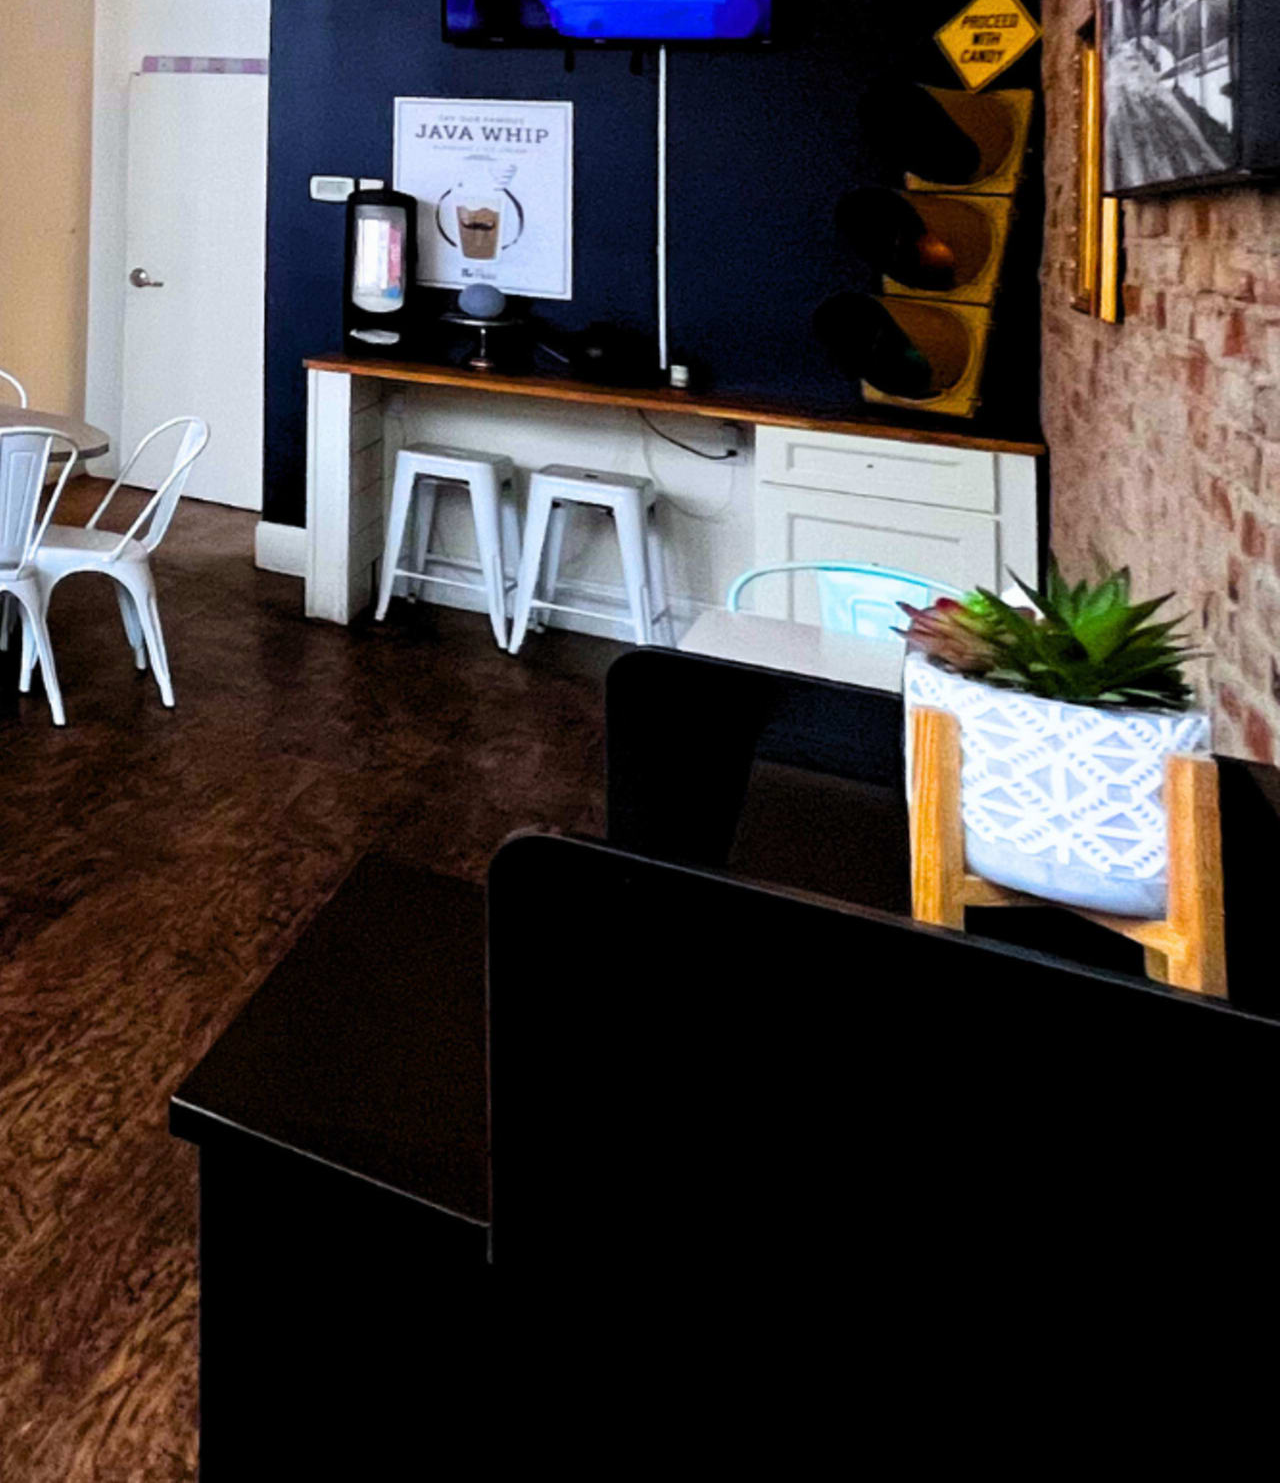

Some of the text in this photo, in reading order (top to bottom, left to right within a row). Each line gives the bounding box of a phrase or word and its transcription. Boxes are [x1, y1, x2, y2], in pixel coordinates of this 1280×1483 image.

[962, 13, 1019, 29] PROCEED
[973, 32, 1002, 45] WITH
[961, 49, 1005, 64] CANDY
[415, 123, 550, 144] JAVA WHIP
